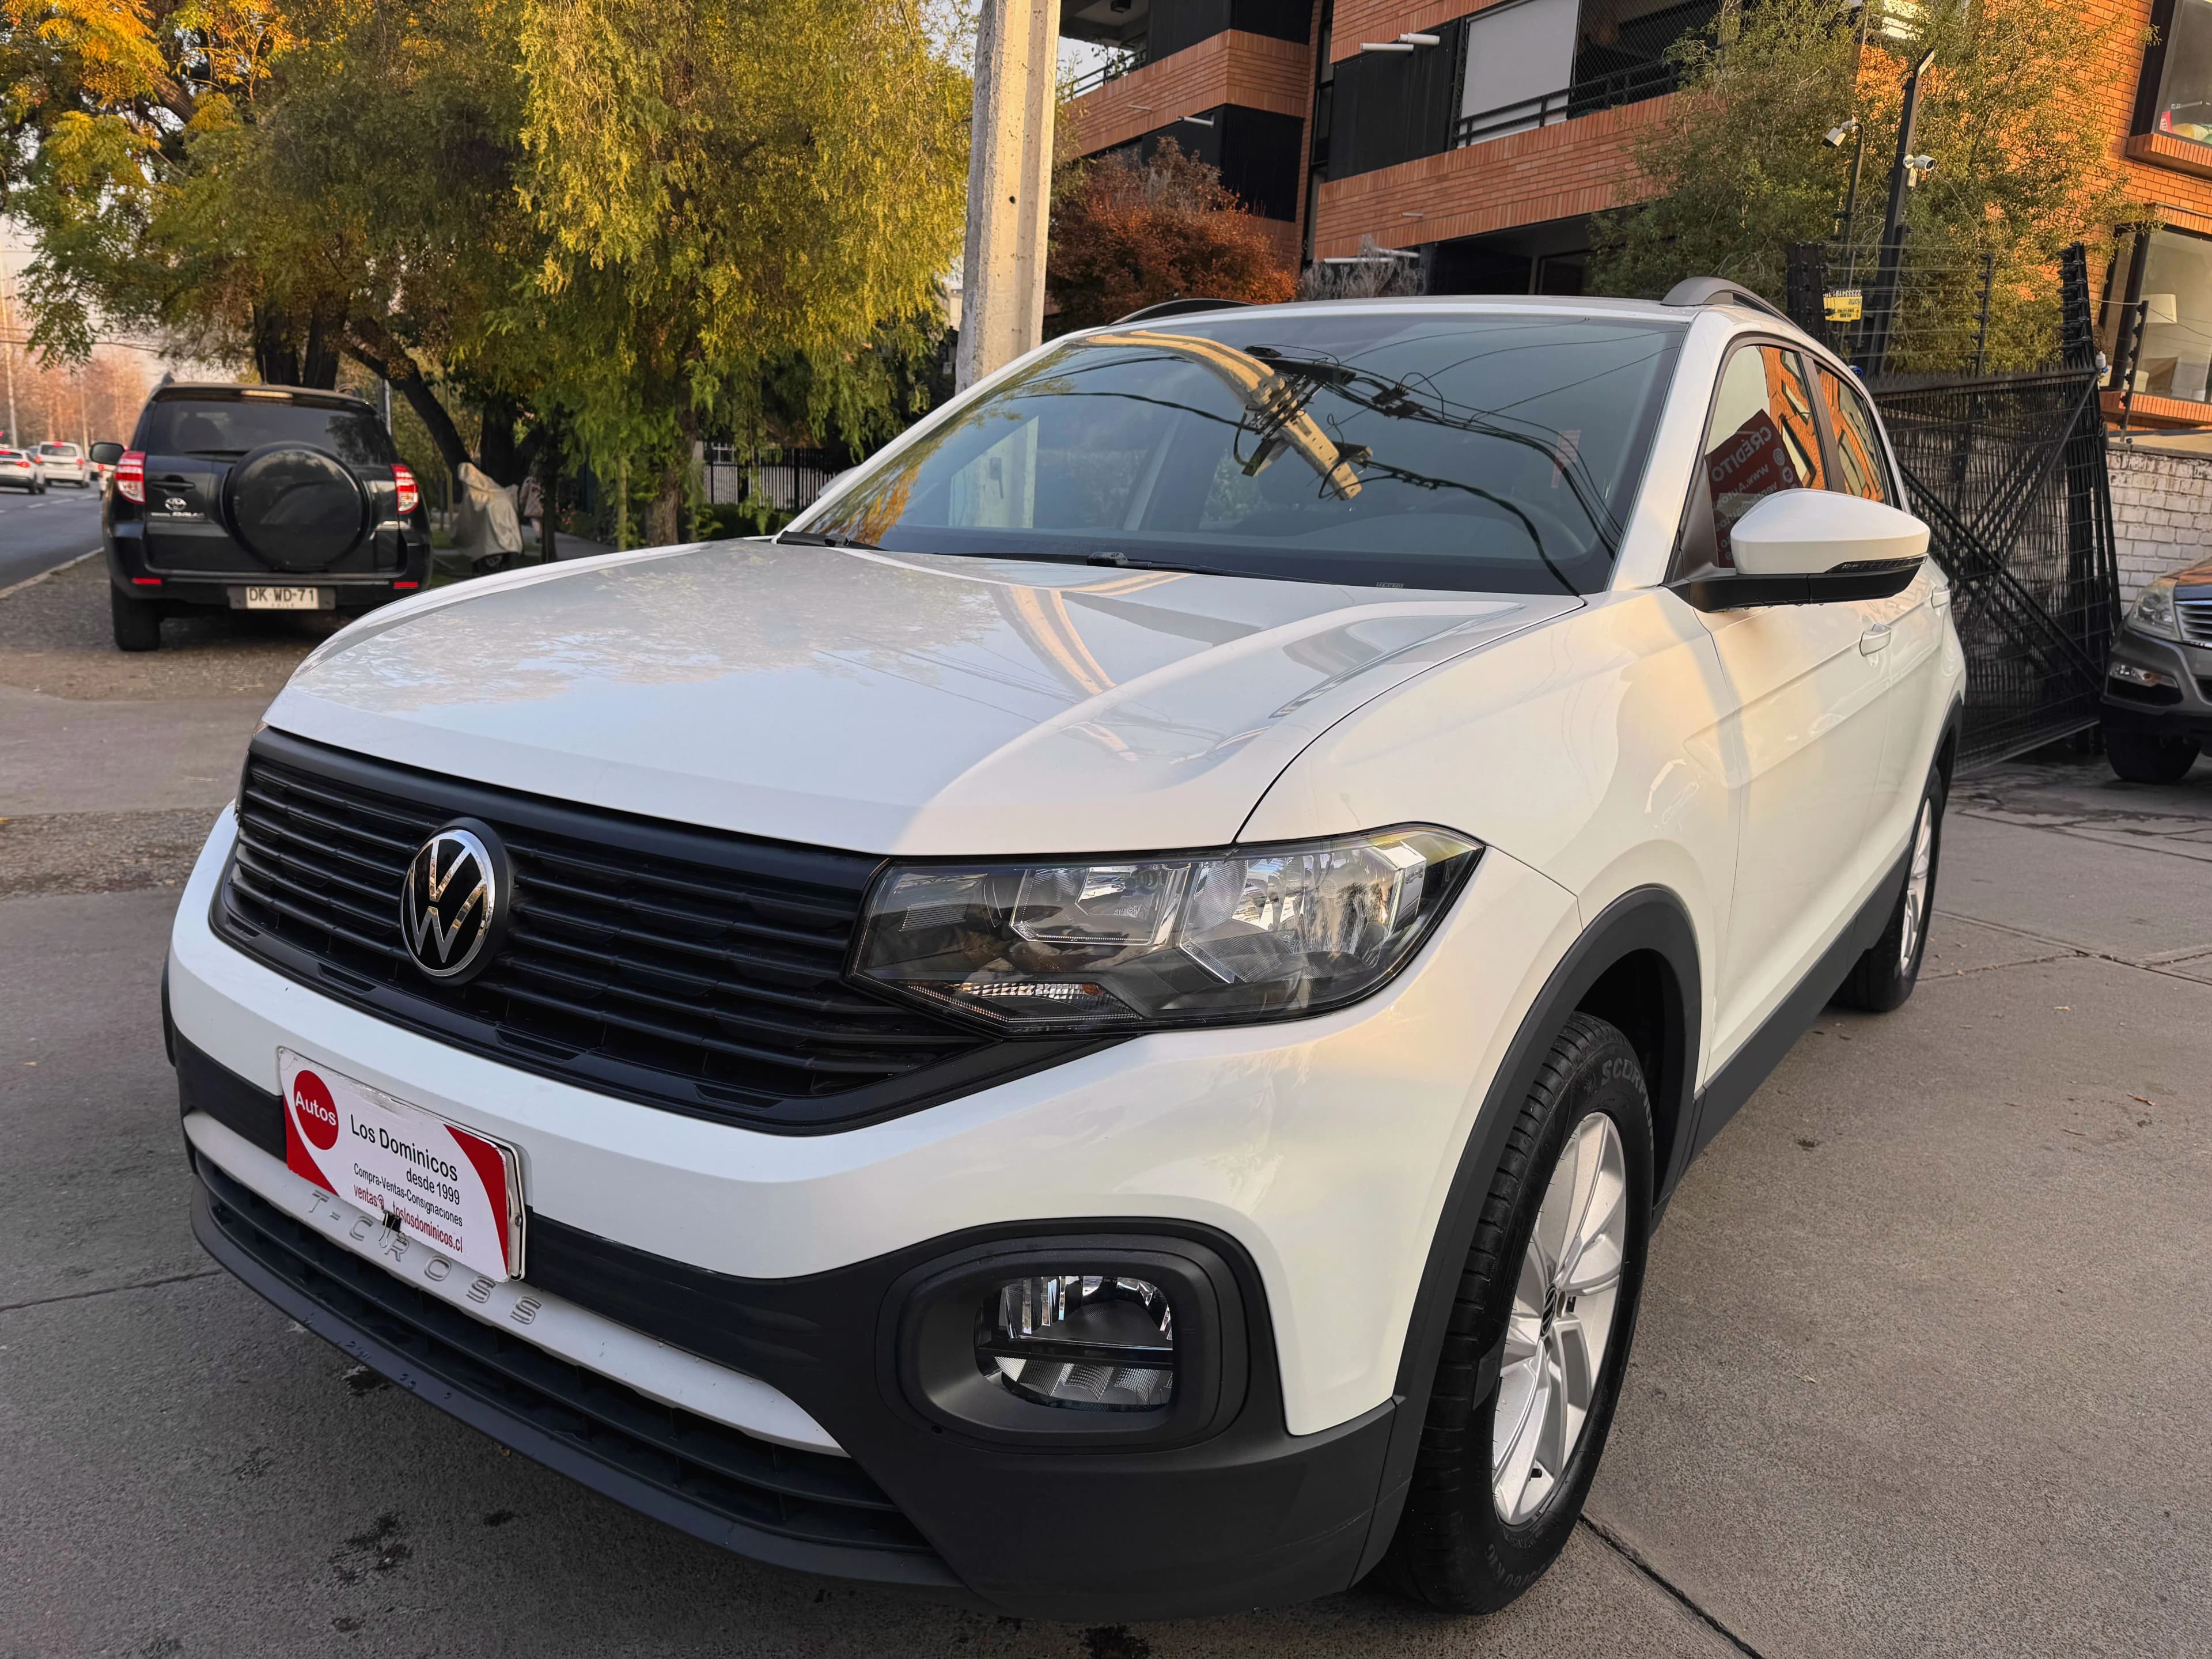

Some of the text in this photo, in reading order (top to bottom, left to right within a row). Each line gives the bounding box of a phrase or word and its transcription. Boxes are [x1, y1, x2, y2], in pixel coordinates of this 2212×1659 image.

[295, 1091, 336, 1126] Autos
[351, 1113, 458, 1181] Los Dominicos
[354, 1162, 463, 1227] Compra-Ventas-Consignaciones
[406, 1167, 460, 1205] desde 1999
[309, 1189, 543, 1325] T-CROSS
